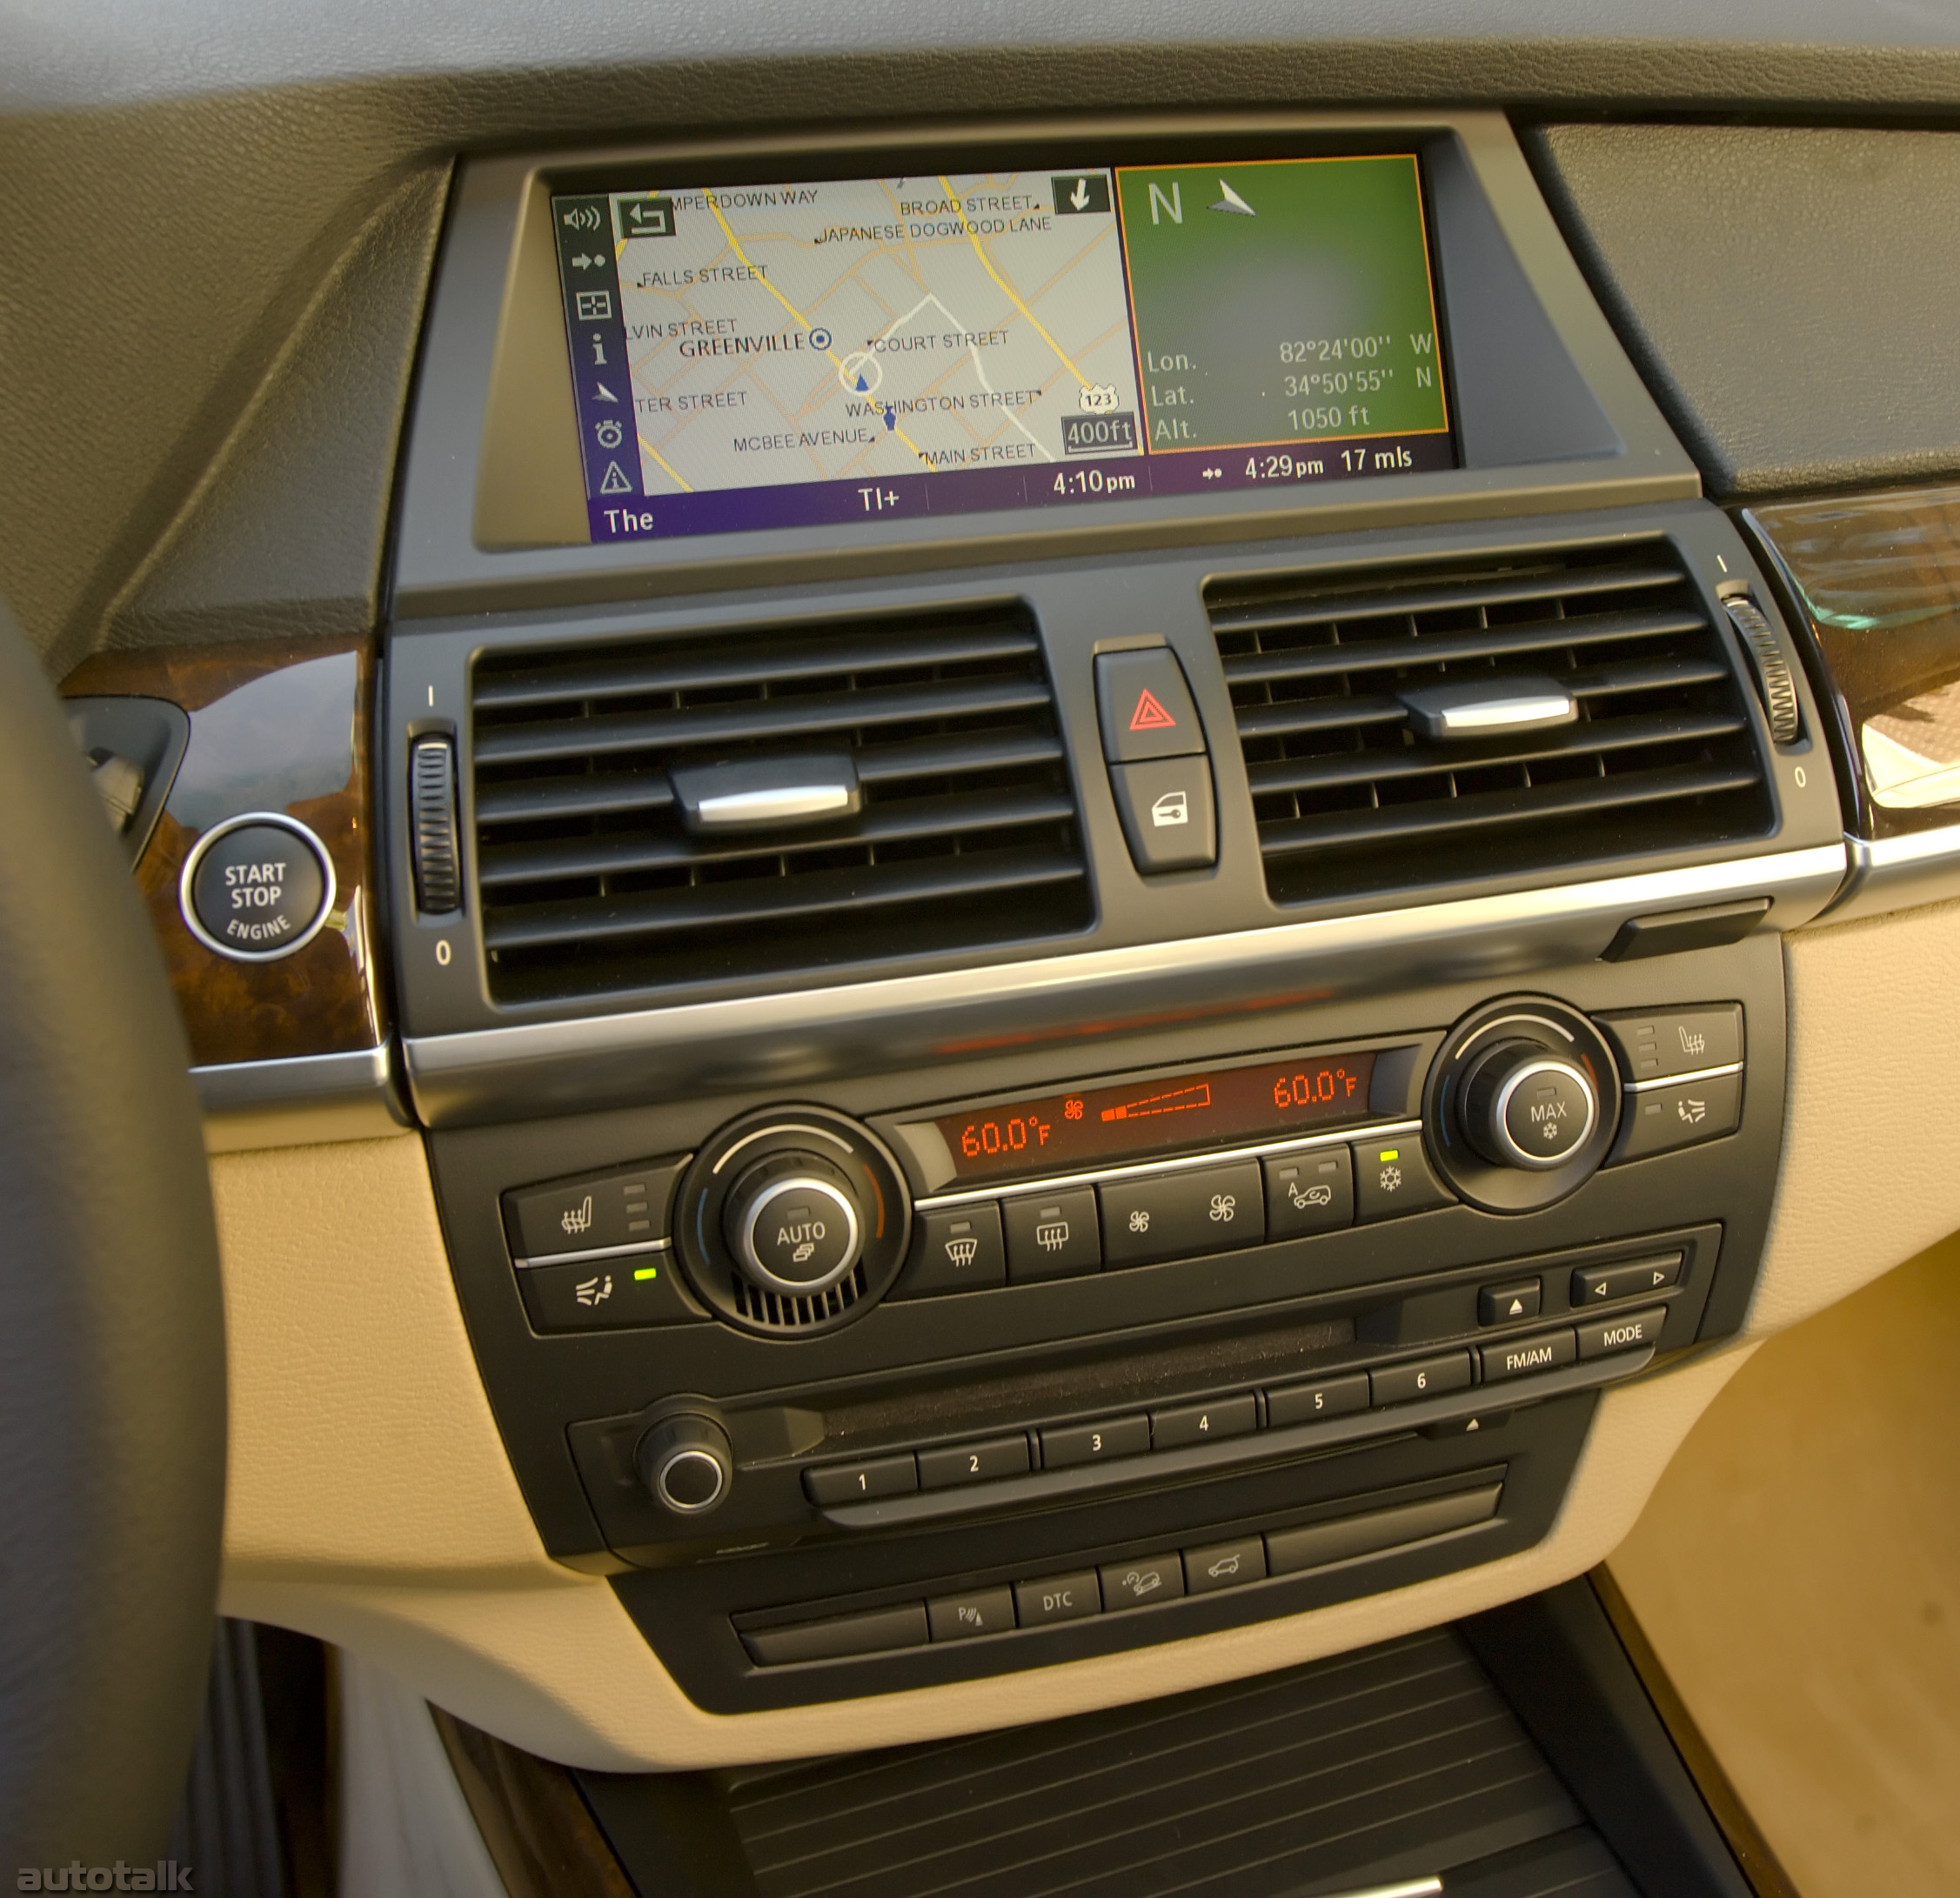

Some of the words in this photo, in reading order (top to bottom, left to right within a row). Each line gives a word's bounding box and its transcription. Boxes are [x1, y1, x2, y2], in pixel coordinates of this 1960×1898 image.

[780, 190, 819, 205] WAY
[900, 199, 961, 216] BROAD
[967, 195, 1033, 212] STREET
[1148, 182, 1183, 225] N
[820, 224, 904, 244] JAPANESE
[910, 219, 1005, 238] DOGWOOD
[1010, 217, 1053, 232] LANE
[643, 270, 694, 287] FALLS
[699, 265, 768, 283] STREET
[668, 319, 738, 337] STREET
[679, 333, 805, 358] GREENVILLE
[873, 336, 937, 353] COURT
[943, 331, 1009, 348] STREET
[1409, 333, 1433, 355] W
[1147, 351, 1197, 372] Lon.
[1415, 366, 1433, 388] N
[635, 398, 672, 413] TER
[678, 392, 747, 411] STREET
[845, 396, 965, 418] WASHINGTON
[969, 391, 1035, 408] STREET
[1084, 394, 1113, 407] 123
[1151, 385, 1194, 407] Lat.
[1288, 407, 1341, 431] 1050
[1348, 404, 1370, 426] ft
[733, 434, 796, 452] MCBEE
[799, 429, 868, 446] AVENUE
[1067, 421, 1132, 445] 400ft
[1154, 418, 1197, 441] Alt.
[925, 448, 966, 465] MAIN
[970, 444, 1036, 462] STREET
[1341, 448, 1367, 471] 17
[1375, 445, 1413, 470] mls
[604, 509, 653, 533] The
[224, 862, 286, 886] START
[231, 886, 282, 909] STOP
[226, 915, 291, 940] ENGINE
[1530, 1100, 1567, 1122] MAX
[1288, 1181, 1299, 1198] A
[777, 1221, 826, 1246] AUTO
[1603, 1324, 1642, 1347] MODE
[1506, 1347, 1553, 1371] FM/AM
[1416, 1373, 1426, 1389] 6
[1314, 1393, 1323, 1409] 5
[1198, 1415, 1209, 1433] 4
[1092, 1434, 1102, 1451] 3
[969, 1455, 980, 1473] 2
[858, 1474, 867, 1491] 1
[1043, 1591, 1073, 1611] DTC
